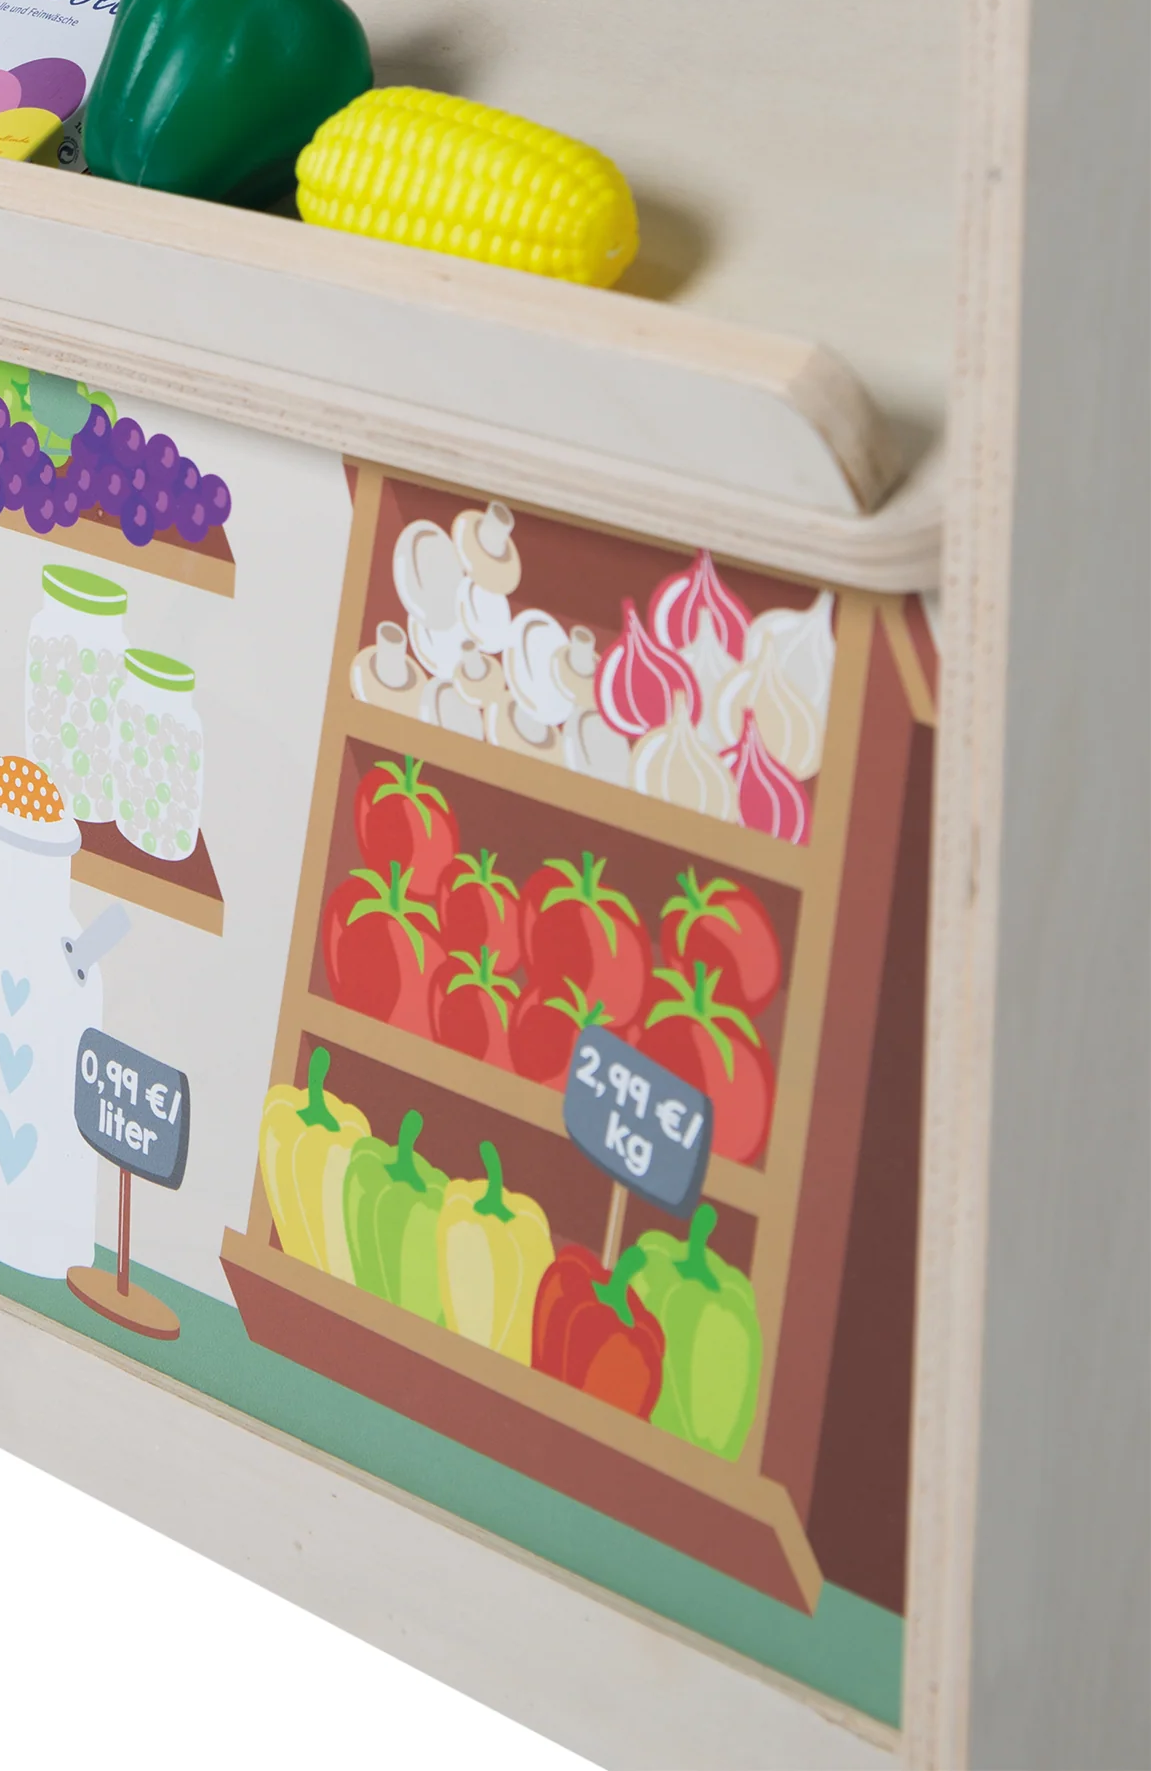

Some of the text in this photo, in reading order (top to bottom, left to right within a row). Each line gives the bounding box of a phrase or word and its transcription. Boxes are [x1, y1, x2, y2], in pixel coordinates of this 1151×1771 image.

[9, 5, 29, 15] und
[27, 8, 79, 27] Feinwäsche
[81, 1049, 182, 1125] 0,99 €/
[576, 1045, 704, 1149] 2,99 €/
[99, 1098, 158, 1156] liter
[605, 1110, 653, 1176] kg
